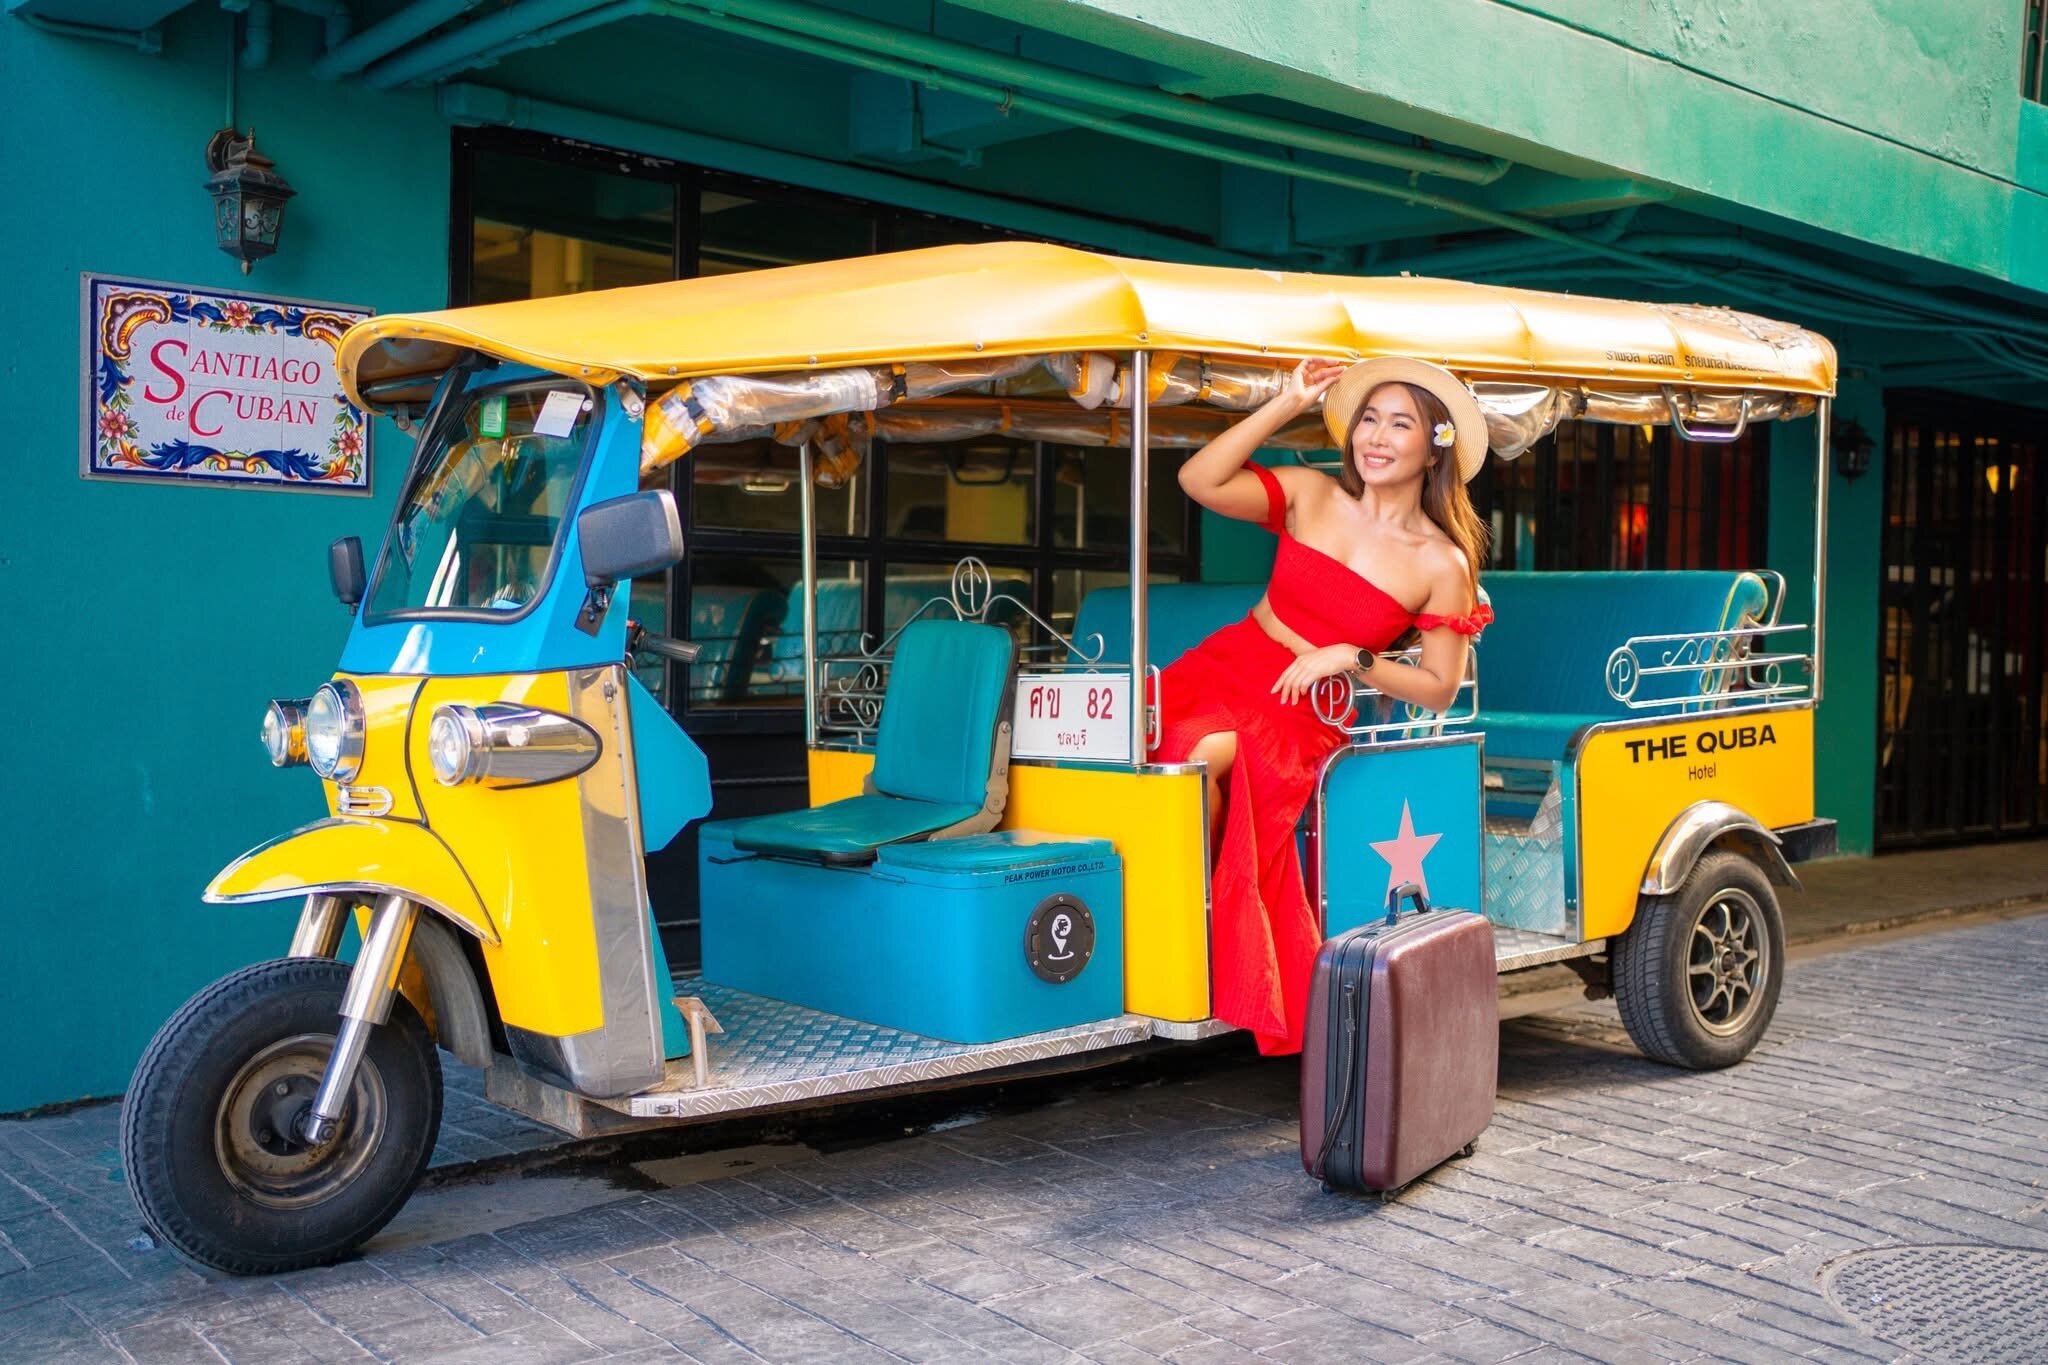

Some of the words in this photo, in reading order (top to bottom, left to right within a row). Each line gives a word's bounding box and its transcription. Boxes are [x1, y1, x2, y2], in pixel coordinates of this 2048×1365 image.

[143, 339, 321, 404] SANTIAGO
[165, 405, 185, 421] de
[189, 390, 319, 437] CUBAN
[1087, 688, 1113, 719] 82
[1057, 729, 1087, 750] ชลบุรี
[1625, 735, 1687, 763] THE
[1696, 724, 1776, 754] QUBA
[1688, 762, 1716, 781] Hotel
[1004, 873, 1023, 883] PEAK
[1025, 869, 1049, 880] POWER
[1051, 865, 1076, 876] MOTOR
